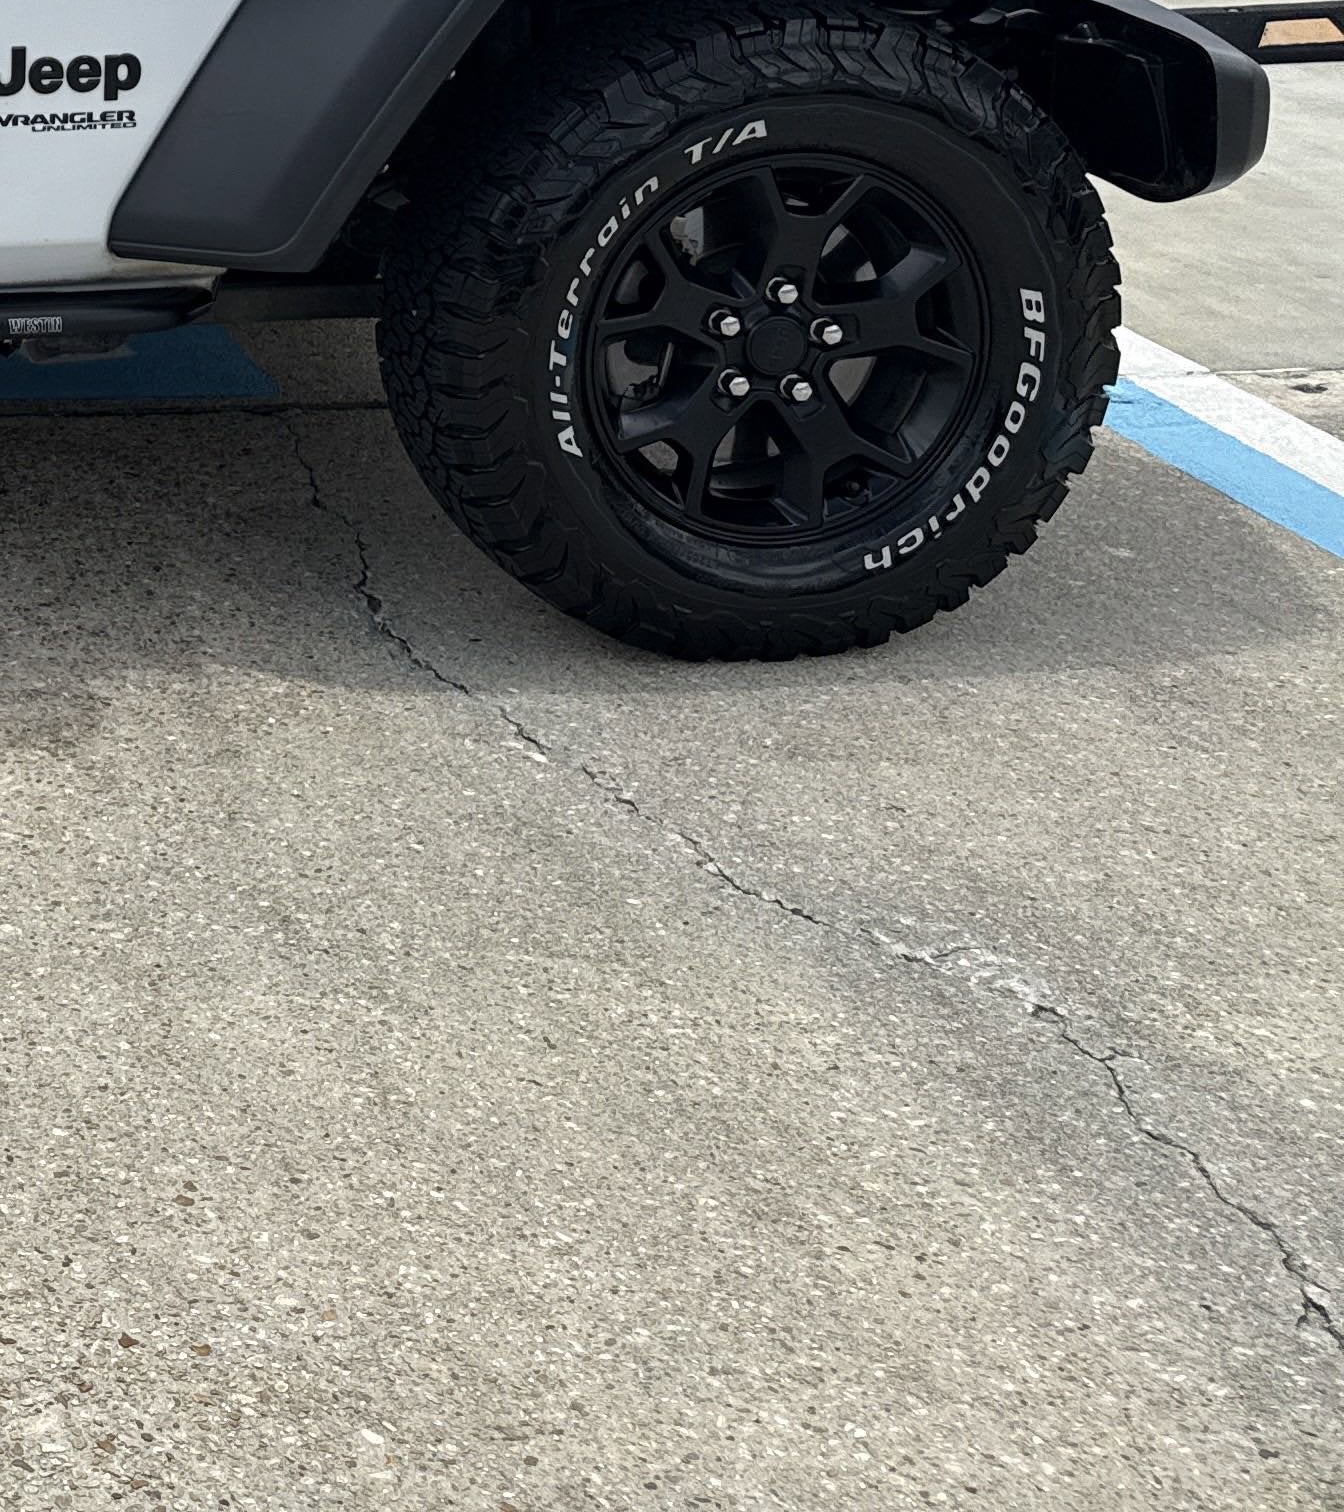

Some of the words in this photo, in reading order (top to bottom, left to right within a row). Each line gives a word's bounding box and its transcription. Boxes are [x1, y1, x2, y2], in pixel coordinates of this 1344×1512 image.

[31, 121, 137, 133] UNLIMITED
[7, 316, 63, 335] WESTIN
[549, 176, 659, 458] All-Terrain
[683, 119, 768, 165] T/A
[864, 287, 1047, 574] BFGoodrich
